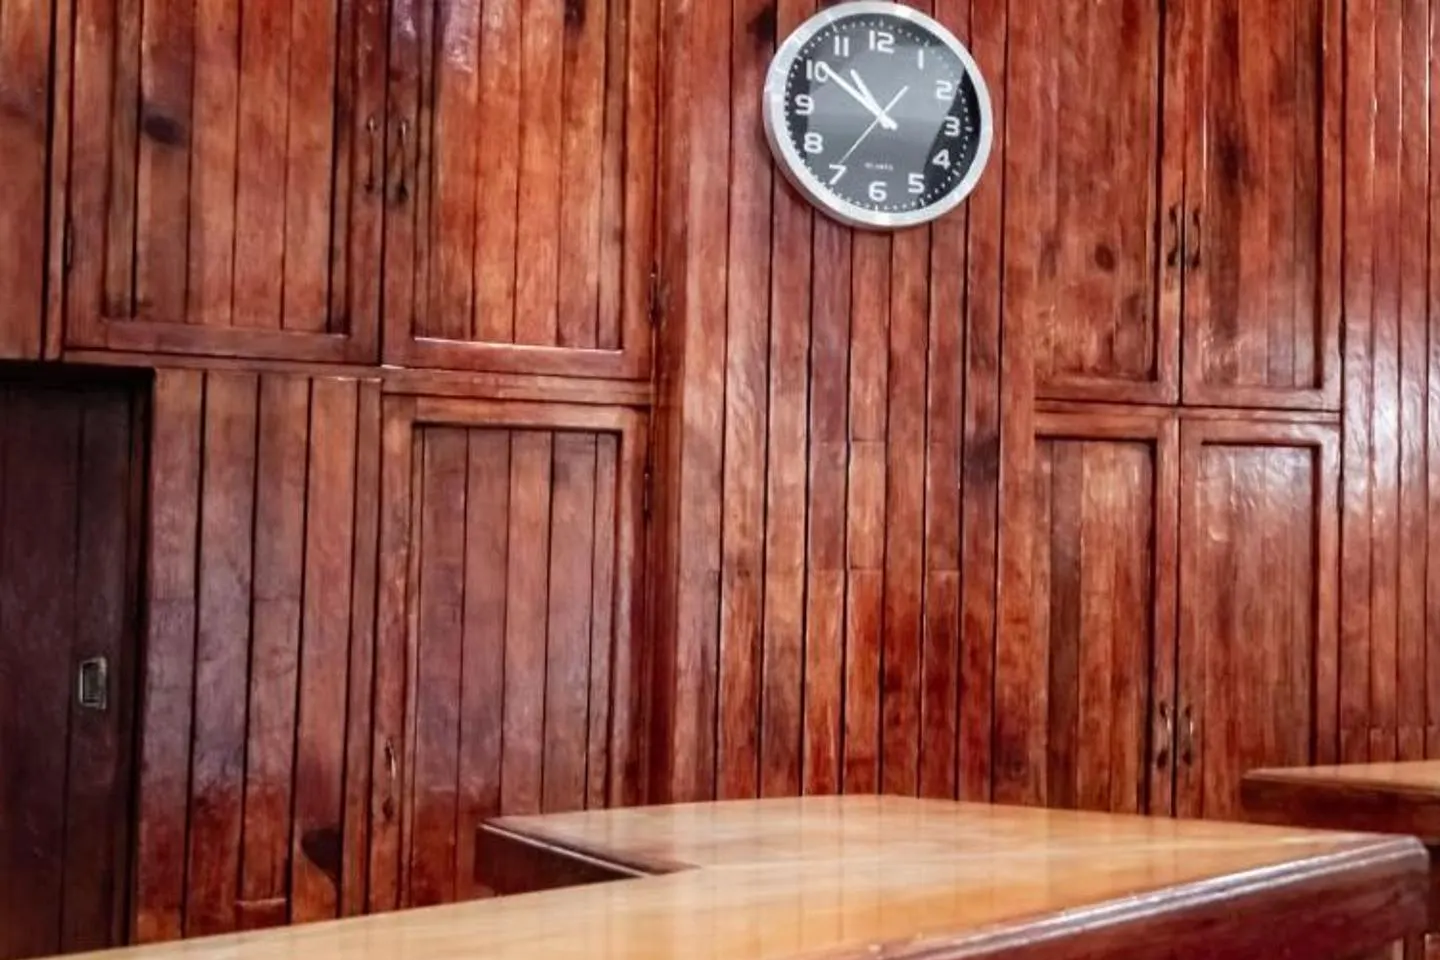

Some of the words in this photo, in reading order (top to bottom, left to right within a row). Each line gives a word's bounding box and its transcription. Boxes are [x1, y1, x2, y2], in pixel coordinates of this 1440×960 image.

[834, 35, 849, 57] 11
[869, 30, 895, 54] 12
[917, 49, 925, 70] 1
[806, 60, 829, 82] 10
[936, 80, 952, 100] 2
[795, 94, 814, 115] 9
[944, 116, 960, 137] 3
[803, 132, 823, 154] 8
[932, 149, 950, 170] 4
[829, 164, 847, 185] 7
[908, 173, 925, 193] 5
[868, 181, 887, 202] 6
